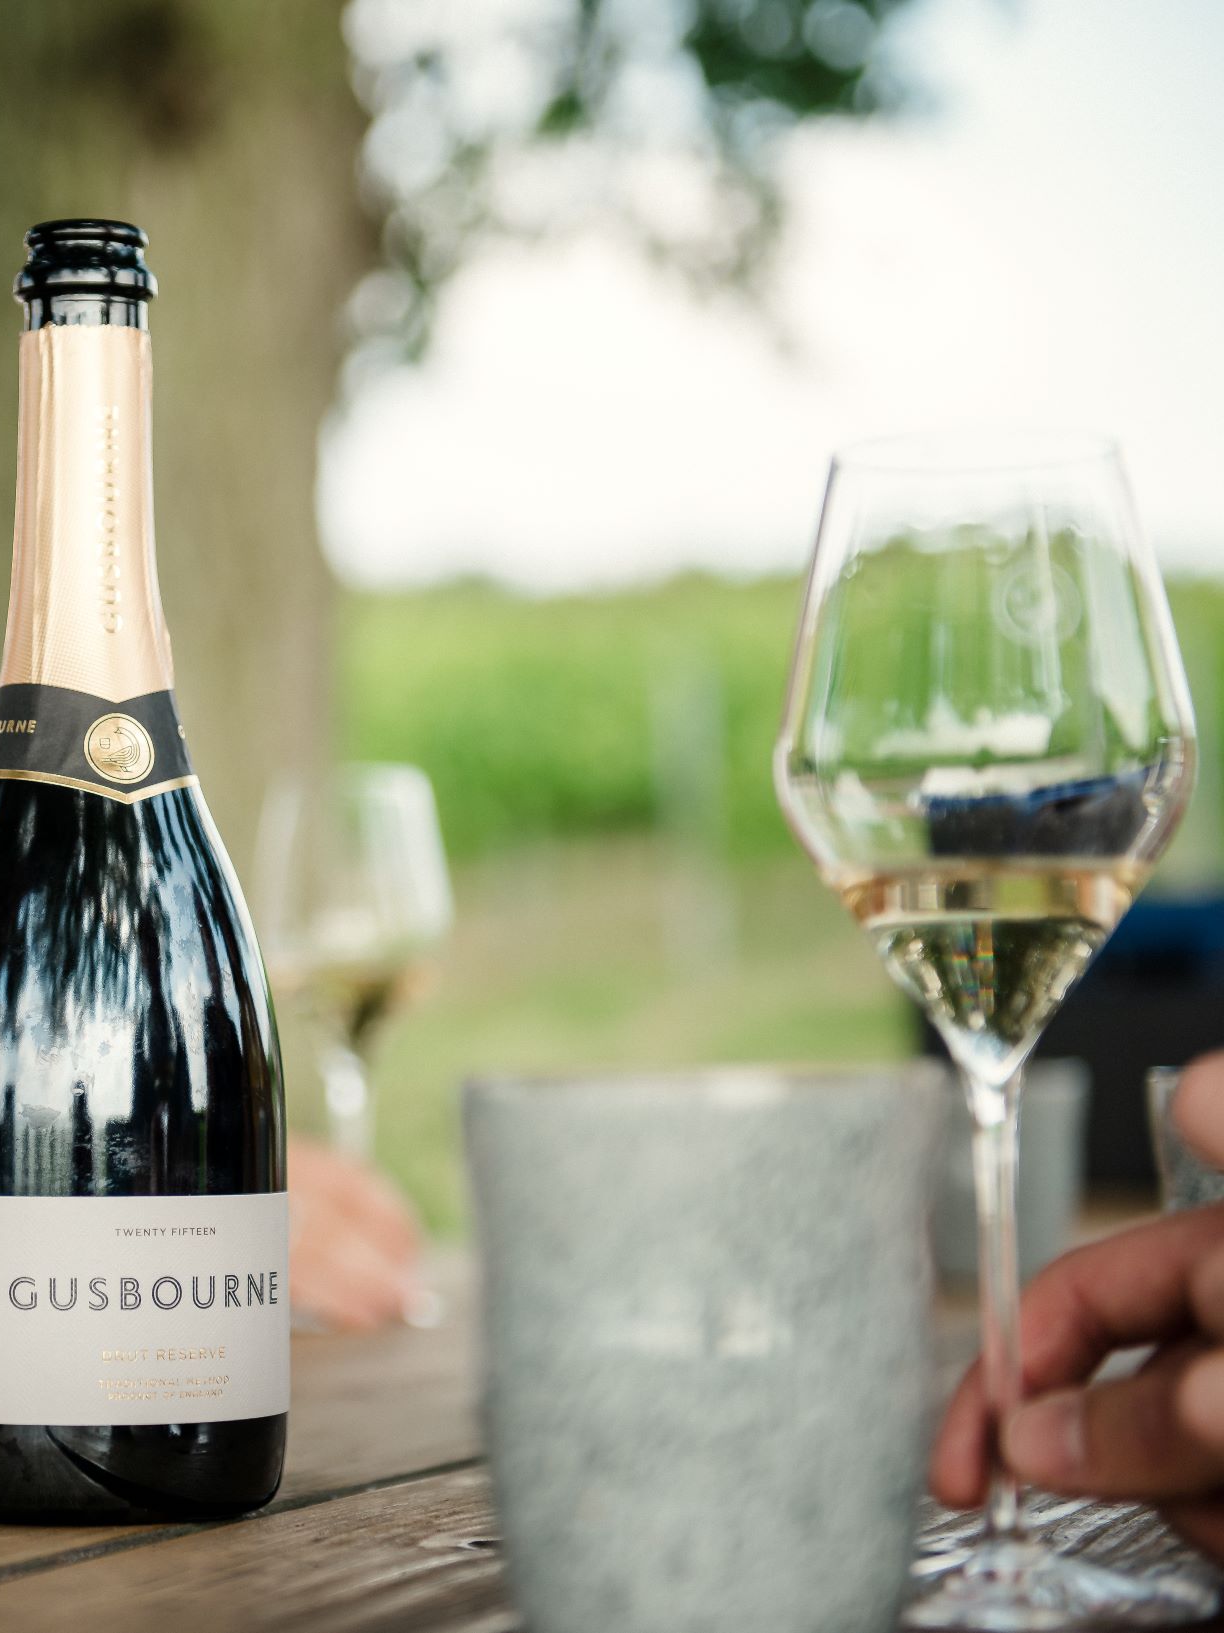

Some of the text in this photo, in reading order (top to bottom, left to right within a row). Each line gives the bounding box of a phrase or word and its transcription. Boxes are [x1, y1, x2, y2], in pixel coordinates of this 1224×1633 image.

[114, 1226, 217, 1237] TWENTY FIFTEEN
[8, 1271, 278, 1311] GUSBOURNE
[101, 1346, 226, 1362] BRUT RESERVE
